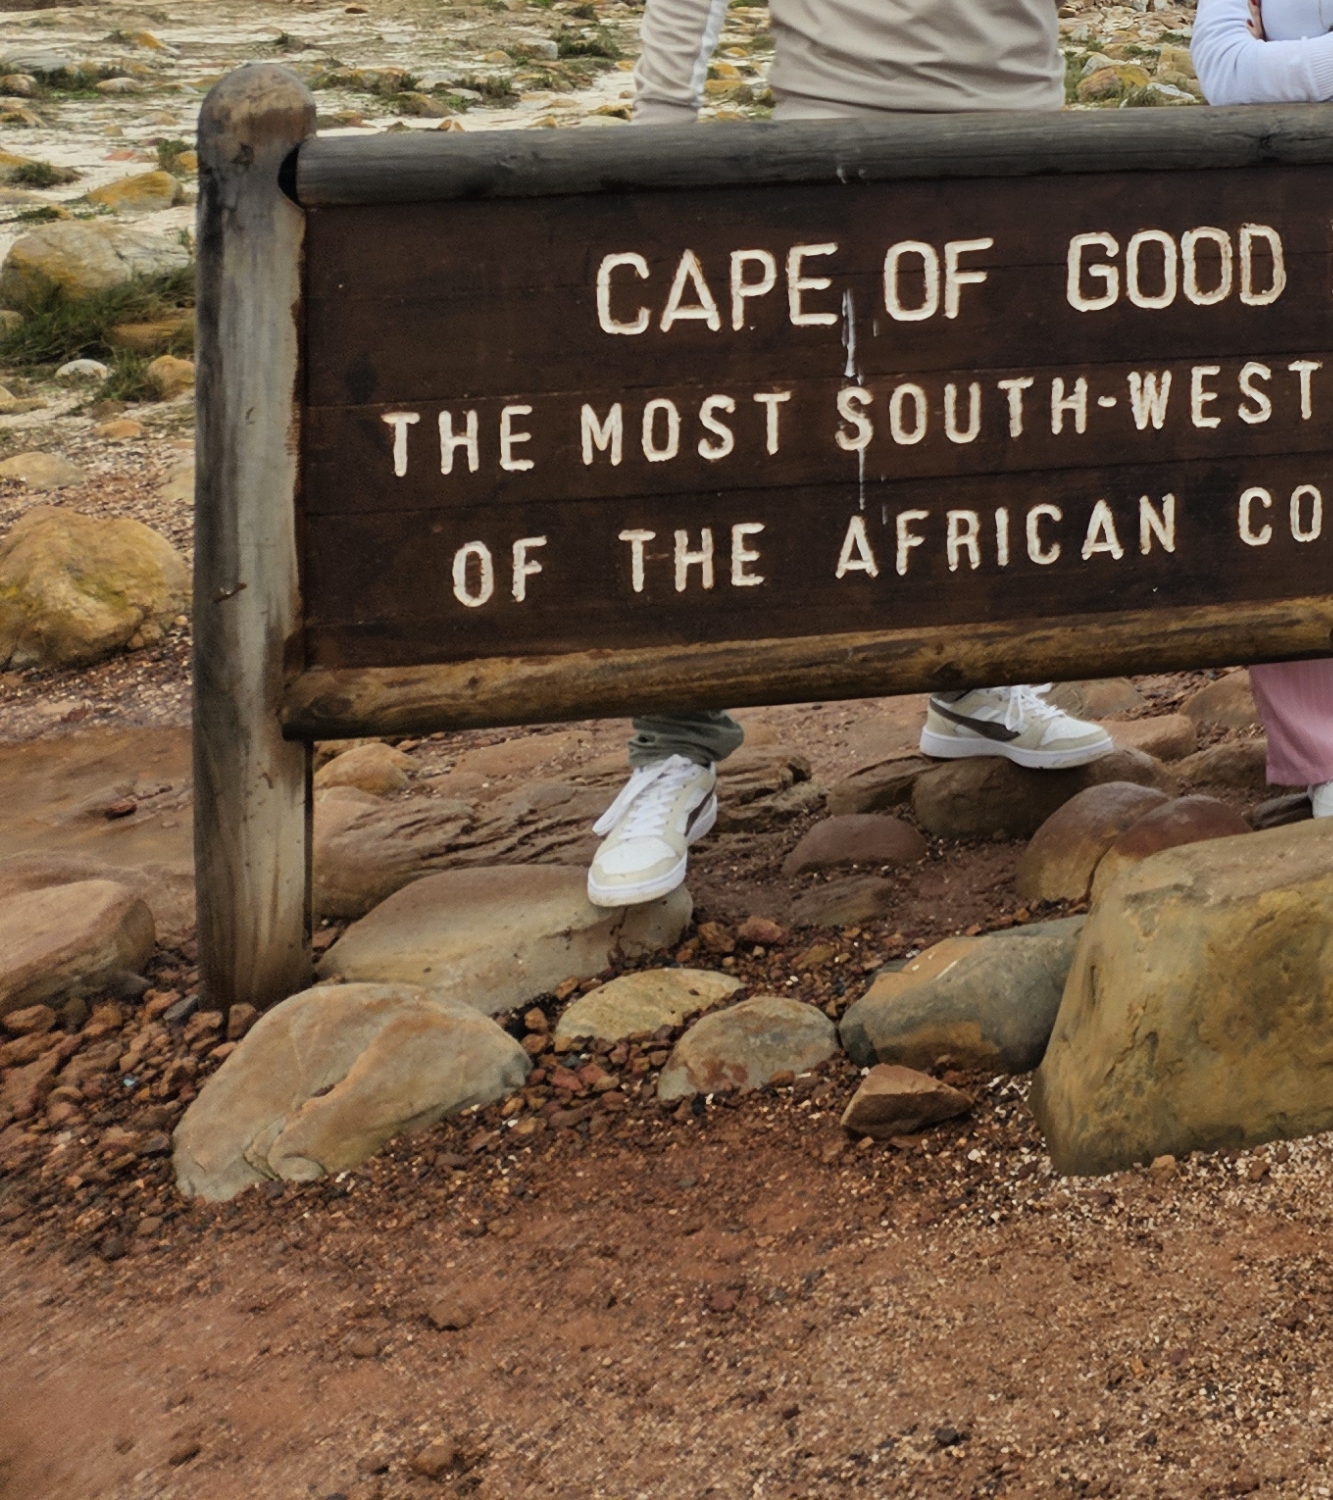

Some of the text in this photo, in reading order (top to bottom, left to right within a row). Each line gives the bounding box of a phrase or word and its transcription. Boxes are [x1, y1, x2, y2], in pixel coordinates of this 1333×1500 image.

[595, 241, 839, 336] CAPE
[882, 236, 994, 323] OF
[1065, 222, 1288, 314] GOOD
[382, 404, 536, 478] THE
[579, 390, 792, 468] MOST
[451, 534, 548, 608] OF
[617, 522, 767, 594] THE
[834, 492, 1176, 580] AFRICAN
